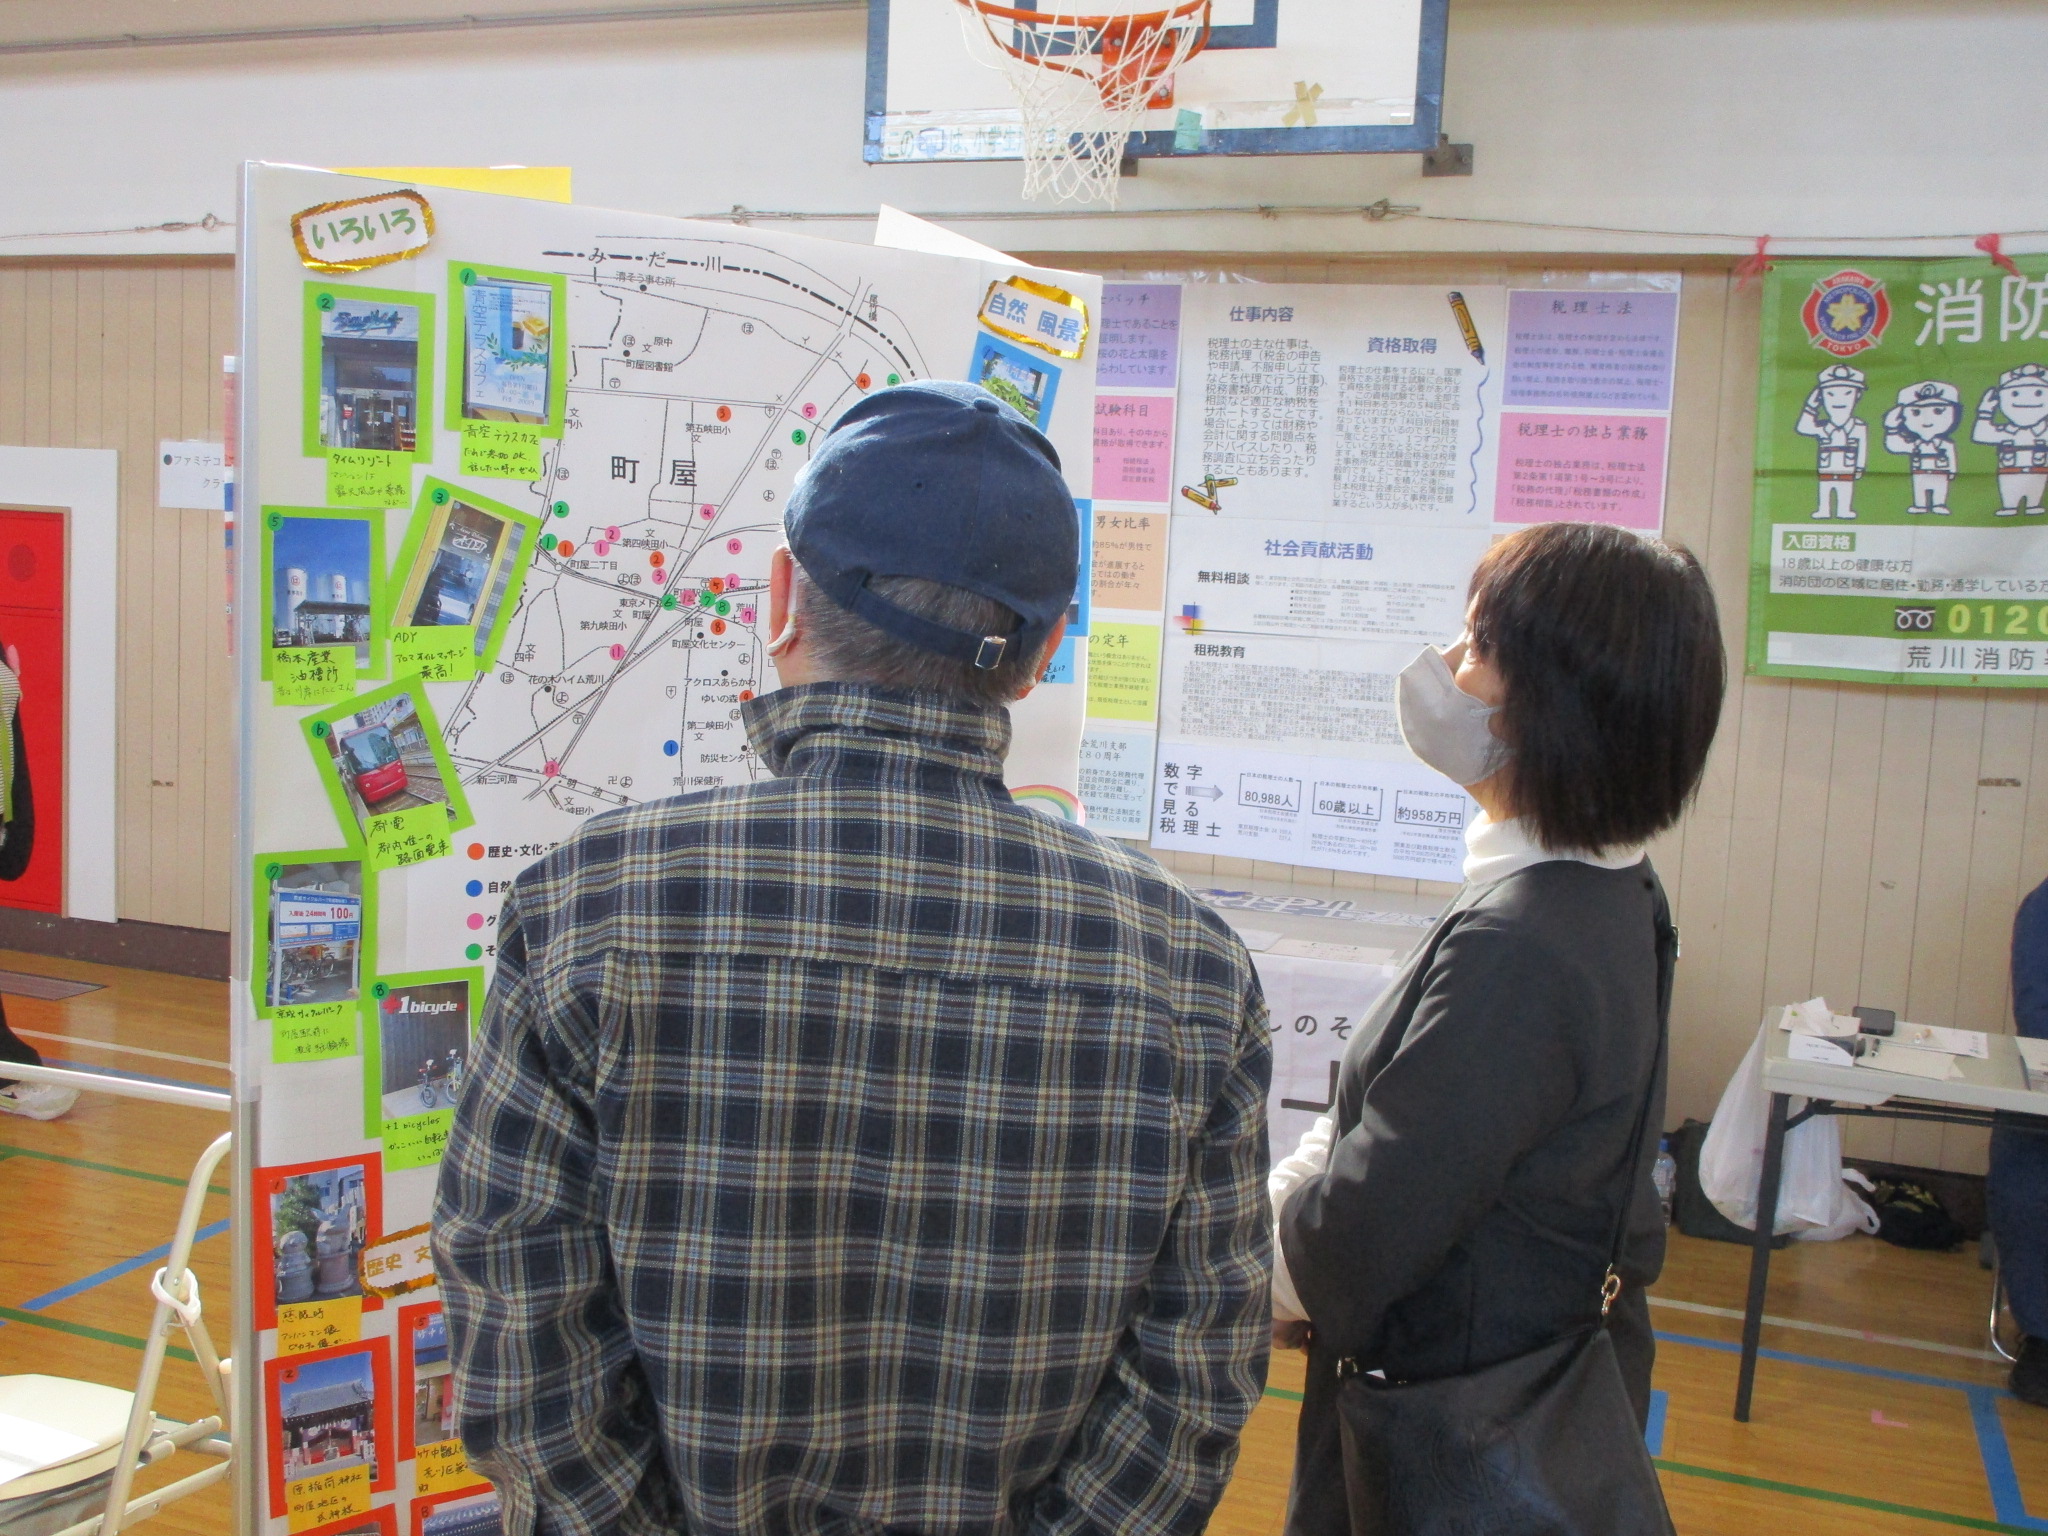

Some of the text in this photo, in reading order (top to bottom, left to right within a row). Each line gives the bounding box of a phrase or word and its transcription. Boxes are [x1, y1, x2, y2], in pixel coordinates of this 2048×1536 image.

[311, 208, 417, 249] いろいろ
[321, 297, 331, 310] 2
[1551, 300, 1633, 315] 税理士法
[1230, 306, 1294, 322] 仕事内容
[1914, 276, 2048, 346] 消防
[987, 292, 1081, 343] 自然 風景
[654, 336, 673, 346] 原中
[1208, 338, 1313, 350] 税理士の主な仕事は、
[1367, 337, 1437, 354] 資格取得
[1827, 342, 1861, 352] TOKYO
[625, 359, 674, 373] 町屋図書館
[1208, 361, 1319, 373] や申請、不服申し立て
[860, 377, 867, 388] 4
[1206, 384, 1319, 396] 税務書類の作成、財務
[1206, 395, 1318, 408] 相談など適正な納税を
[719, 409, 726, 418] 3
[806, 406, 813, 417] 5
[1095, 403, 1148, 417] 試験科目
[1204, 407, 1323, 420] サポートすることです。
[685, 423, 731, 435] 第五峡田小
[1204, 418, 1318, 431] 場合によっては財務や
[795, 431, 802, 442] 3
[1203, 429, 1316, 442] 会計に関する問題点を
[1518, 422, 1649, 441] 税理士の独占業務
[1203, 440, 1317, 454] アドバイスしたり、税
[1202, 452, 1315, 466] 務調査に立ち会ったり
[611, 456, 697, 488] 町屋
[1202, 464, 1308, 478] することもあります。
[436, 492, 444, 504] 3
[557, 505, 564, 514] 2
[703, 507, 711, 518] 4
[270, 516, 279, 527] 5
[1095, 515, 1151, 531] 男女比率
[609, 529, 615, 539] 2
[622, 539, 669, 550] 第四峡田小
[728, 542, 739, 551] 10
[1784, 534, 1852, 551] 入団資格
[1264, 539, 1374, 561] 社会貢献活動
[570, 560, 618, 571] 町屋二丁目
[653, 555, 660, 564] 2
[1781, 557, 1913, 573] 18歳以上の健康な方
[656, 572, 662, 582] 3
[729, 577, 735, 588] 6
[1197, 570, 1250, 585] 無料相談
[664, 599, 673, 607] 6
[719, 602, 726, 612] 8
[633, 610, 651, 620] 町屋
[745, 611, 751, 621] 7
[580, 621, 627, 631] 第九峡田小
[685, 618, 703, 627] 町屋
[715, 621, 721, 632] 8
[394, 631, 418, 643] ADY
[1089, 633, 1129, 648] の定年
[672, 640, 746, 649] 町屋文化センター
[1193, 643, 1246, 658] 租税教育
[277, 650, 336, 666] 橋本産業
[514, 653, 535, 663] 四中
[1906, 645, 2048, 672] 荒川消防
[528, 675, 605, 685] 花の木ハイム荒川
[684, 678, 757, 687] アクロスあらかわ
[701, 695, 738, 703] ゆいの森
[315, 724, 325, 735] 6
[687, 721, 733, 731] 第二峡田小
[700, 754, 754, 763] 防災センター
[1163, 762, 1203, 779] 数字
[476, 774, 518, 785] 新三河島
[673, 776, 724, 787] 荒川保健所
[1163, 782, 1178, 797] で
[1161, 799, 1200, 818] 見る
[1319, 800, 1374, 816] 60歳以上
[1398, 806, 1462, 825] 約958万円
[370, 815, 404, 838] 都電
[1159, 816, 1222, 838] 税理士
[375, 984, 385, 997] 8
[403, 1116, 440, 1131] bicycles
[366, 1253, 403, 1278] 歴史
